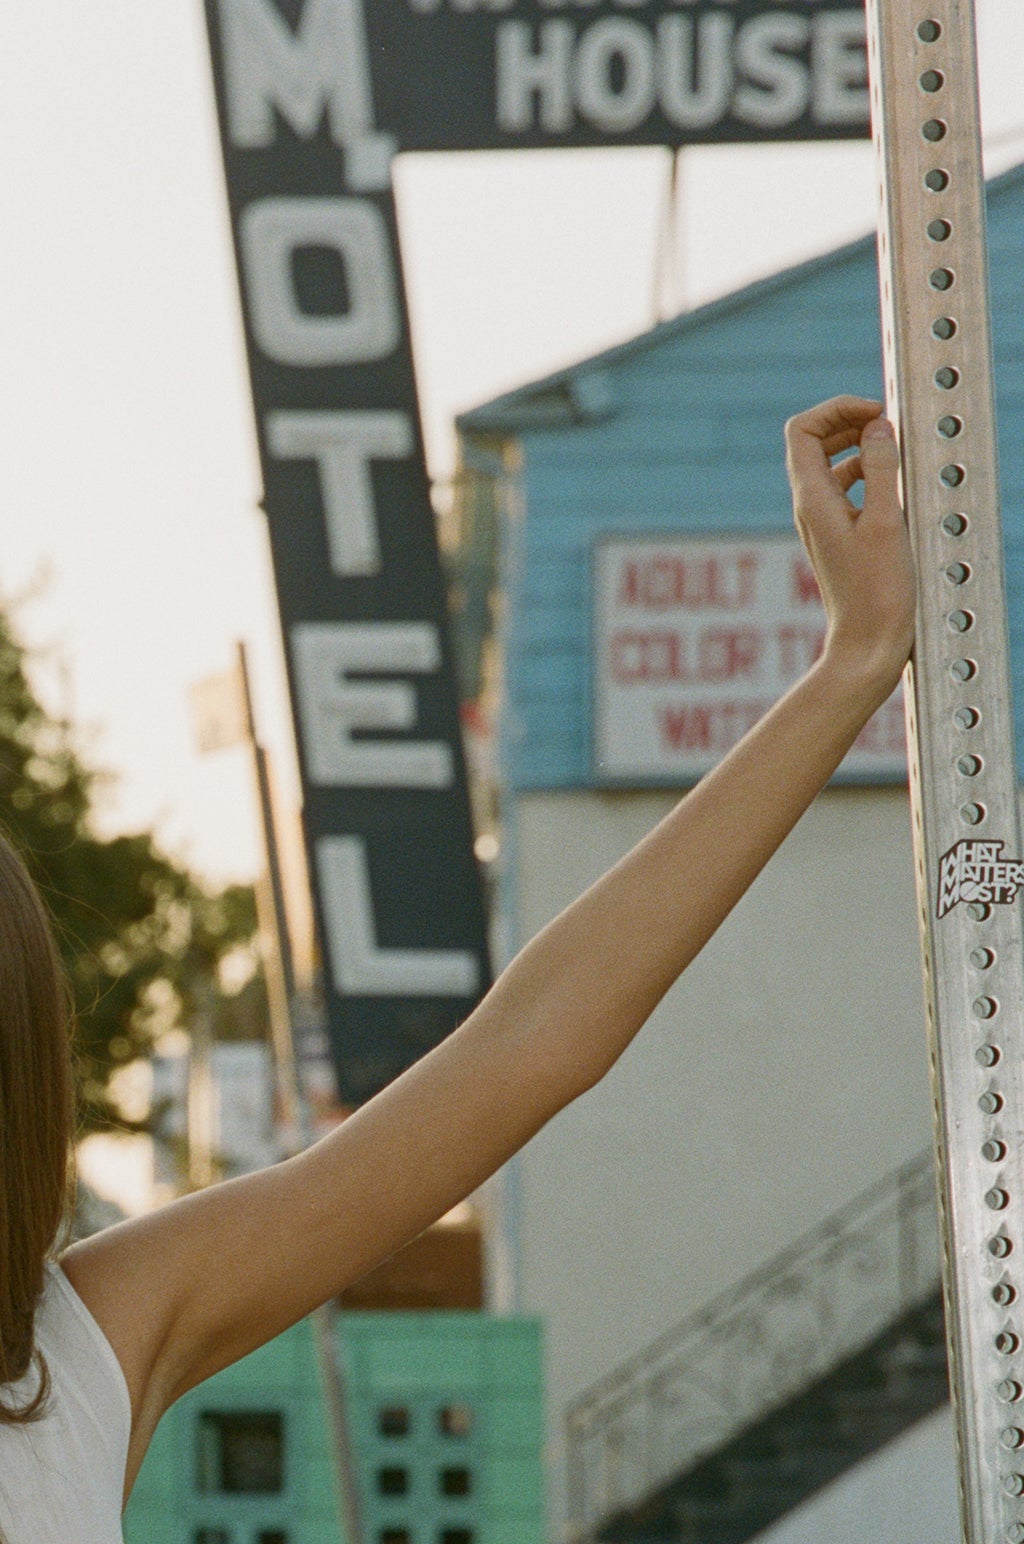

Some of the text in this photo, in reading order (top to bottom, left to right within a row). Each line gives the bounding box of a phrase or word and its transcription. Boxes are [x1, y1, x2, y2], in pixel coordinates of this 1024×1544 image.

[495, 10, 872, 133] HOUSE
[219, 0, 480, 995] MOTEL
[619, 554, 757, 610] ADULT
[612, 625, 759, 683] COLOR
[941, 842, 1002, 878] WHAT
